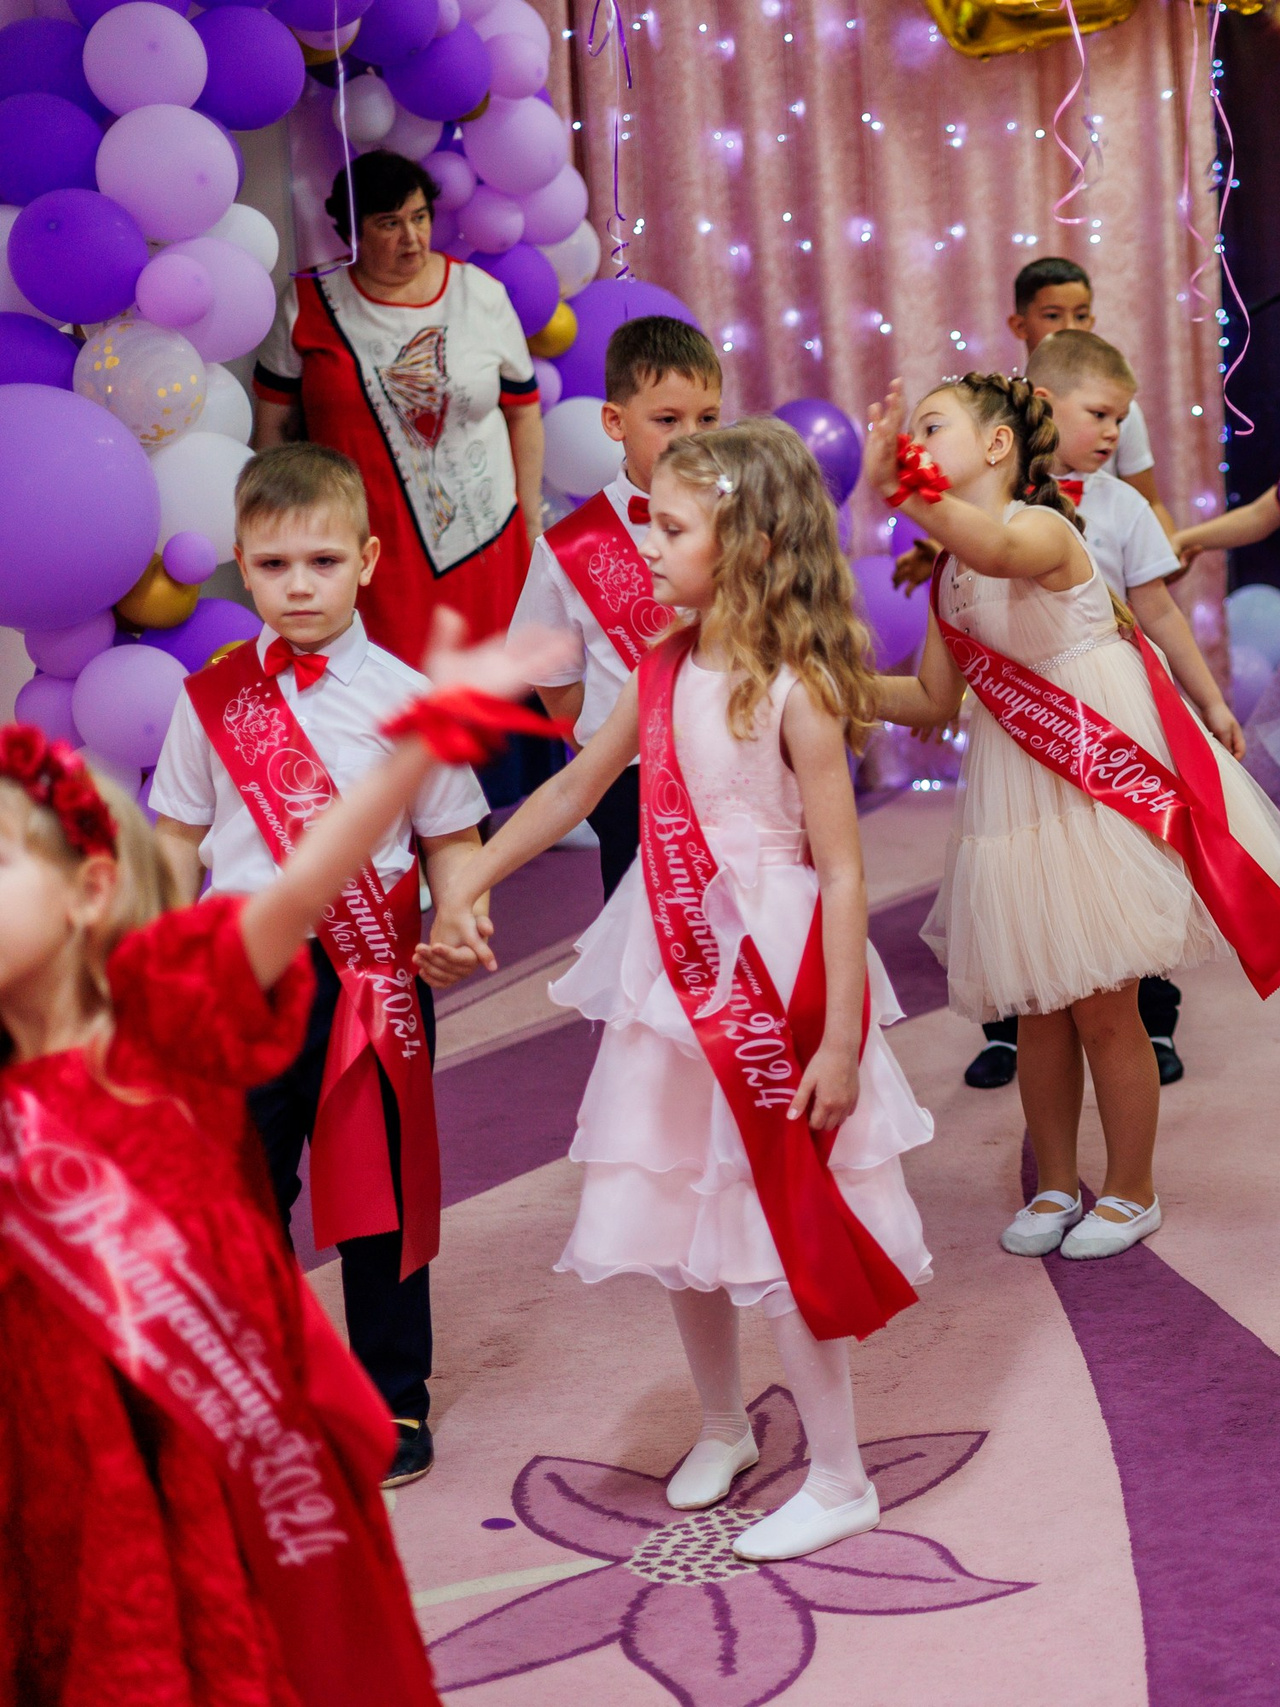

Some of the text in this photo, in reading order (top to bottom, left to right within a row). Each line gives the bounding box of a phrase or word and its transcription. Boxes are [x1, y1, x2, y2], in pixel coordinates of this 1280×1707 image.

[944, 635, 1178, 814] Выпускница 2024
[1029, 735, 1071, 766] №4
[240, 780, 297, 855] детского
[383, 907, 399, 942] Егор
[654, 892, 675, 938] сада
[670, 941, 709, 998] №4
[366, 967, 422, 1061] 2024
[719, 1011, 799, 1110] 2024
[252, 1430, 350, 1567] 2024
